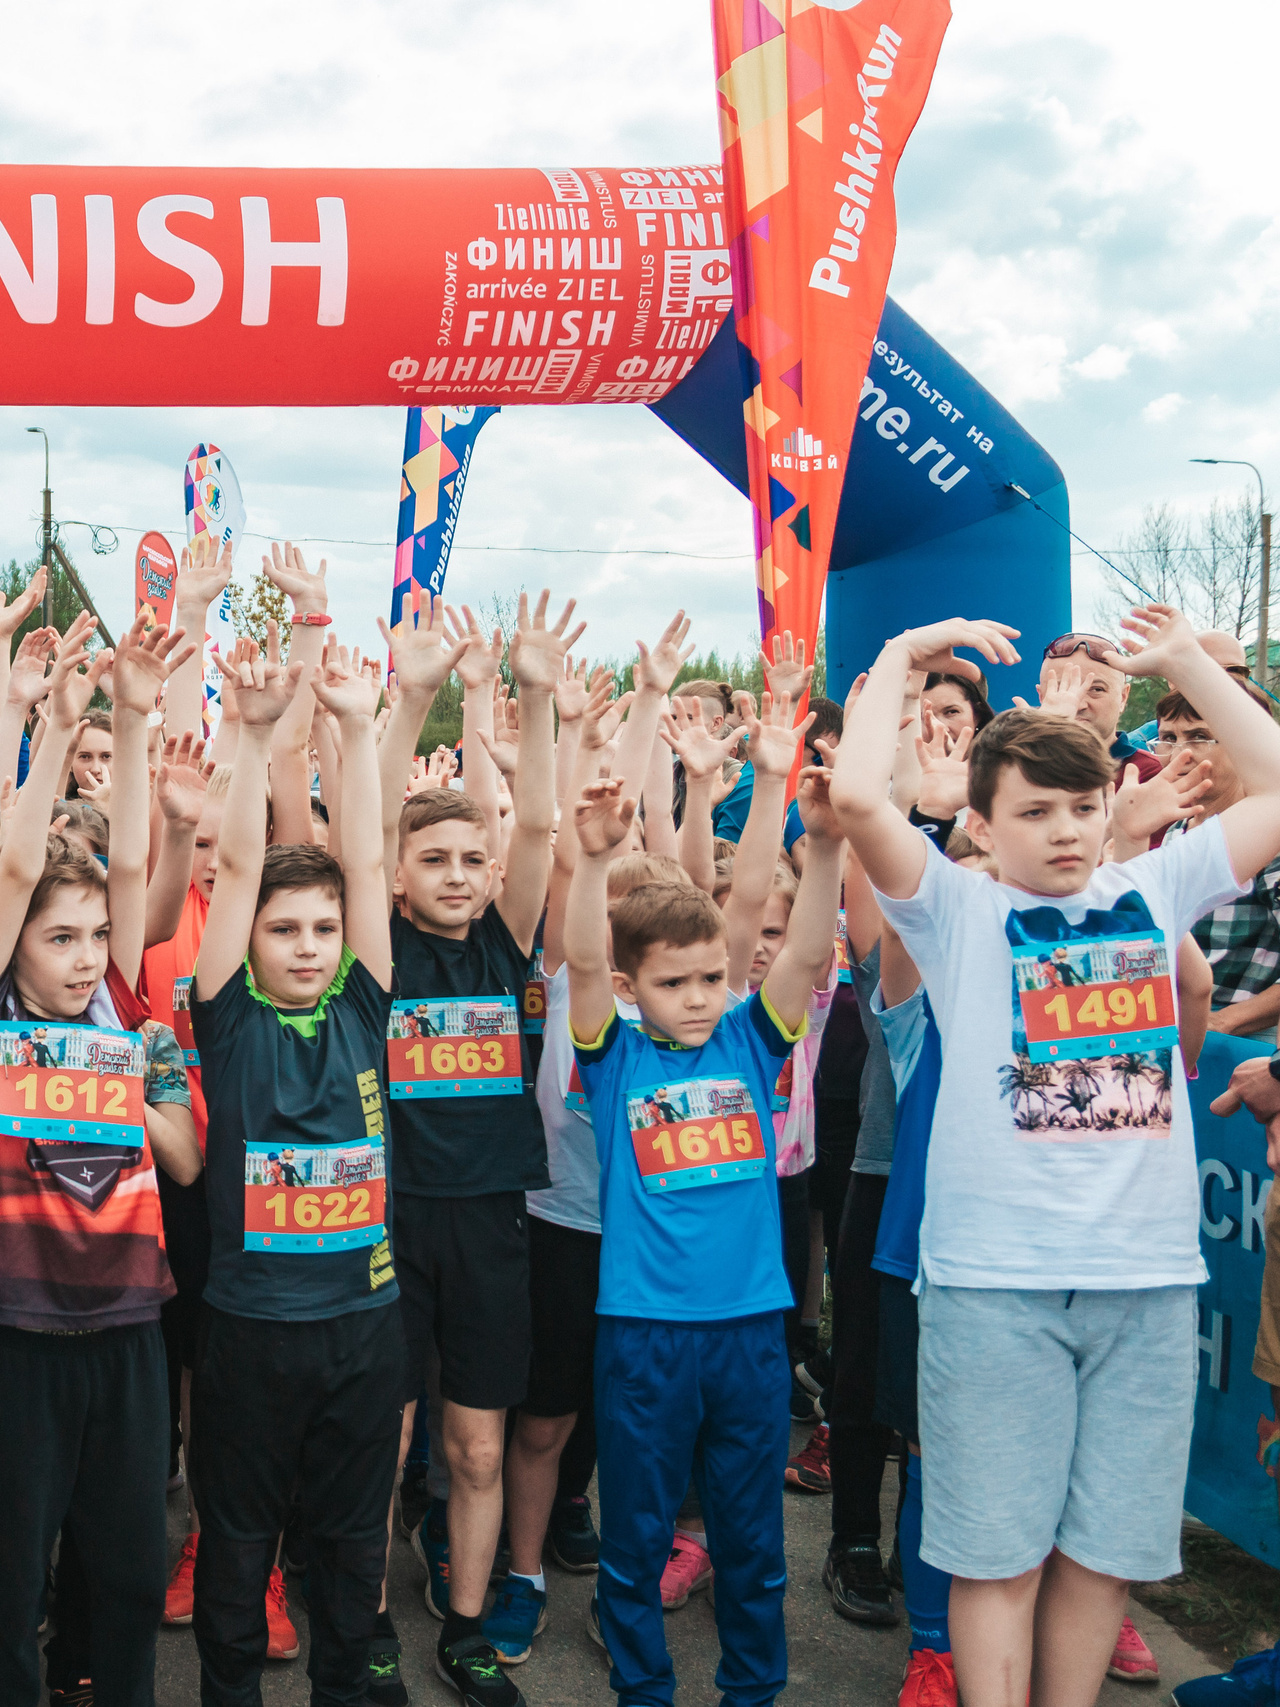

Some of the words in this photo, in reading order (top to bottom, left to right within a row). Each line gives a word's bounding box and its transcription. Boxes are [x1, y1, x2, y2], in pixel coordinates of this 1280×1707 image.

[808, 24, 902, 298] PushkinRun
[624, 190, 694, 205] ZIEL
[703, 192, 725, 204] ar
[494, 203, 590, 231] Ziellinie
[467, 237, 621, 270] ФИНИШ
[437, 251, 458, 347] ZAKOŃCZYĆ
[466, 278, 547, 300] arrivée
[557, 278, 625, 302] ZIEL
[628, 254, 655, 348] VIIMISTLUS
[463, 310, 616, 346] FINISH
[387, 356, 544, 382] ФИНИШ
[398, 384, 533, 394] TERMINAR
[597, 384, 661, 396] ZIEL
[873, 334, 965, 425] езультат
[966, 425, 995, 455] на
[771, 453, 838, 473] КОВЭЙ
[429, 443, 471, 594] PushkinRun
[1045, 984, 1157, 1032] 1491
[405, 1041, 505, 1075] 1663
[15, 1073, 128, 1117] 1612
[652, 1119, 753, 1165] 1615
[265, 1188, 371, 1228] 1622
